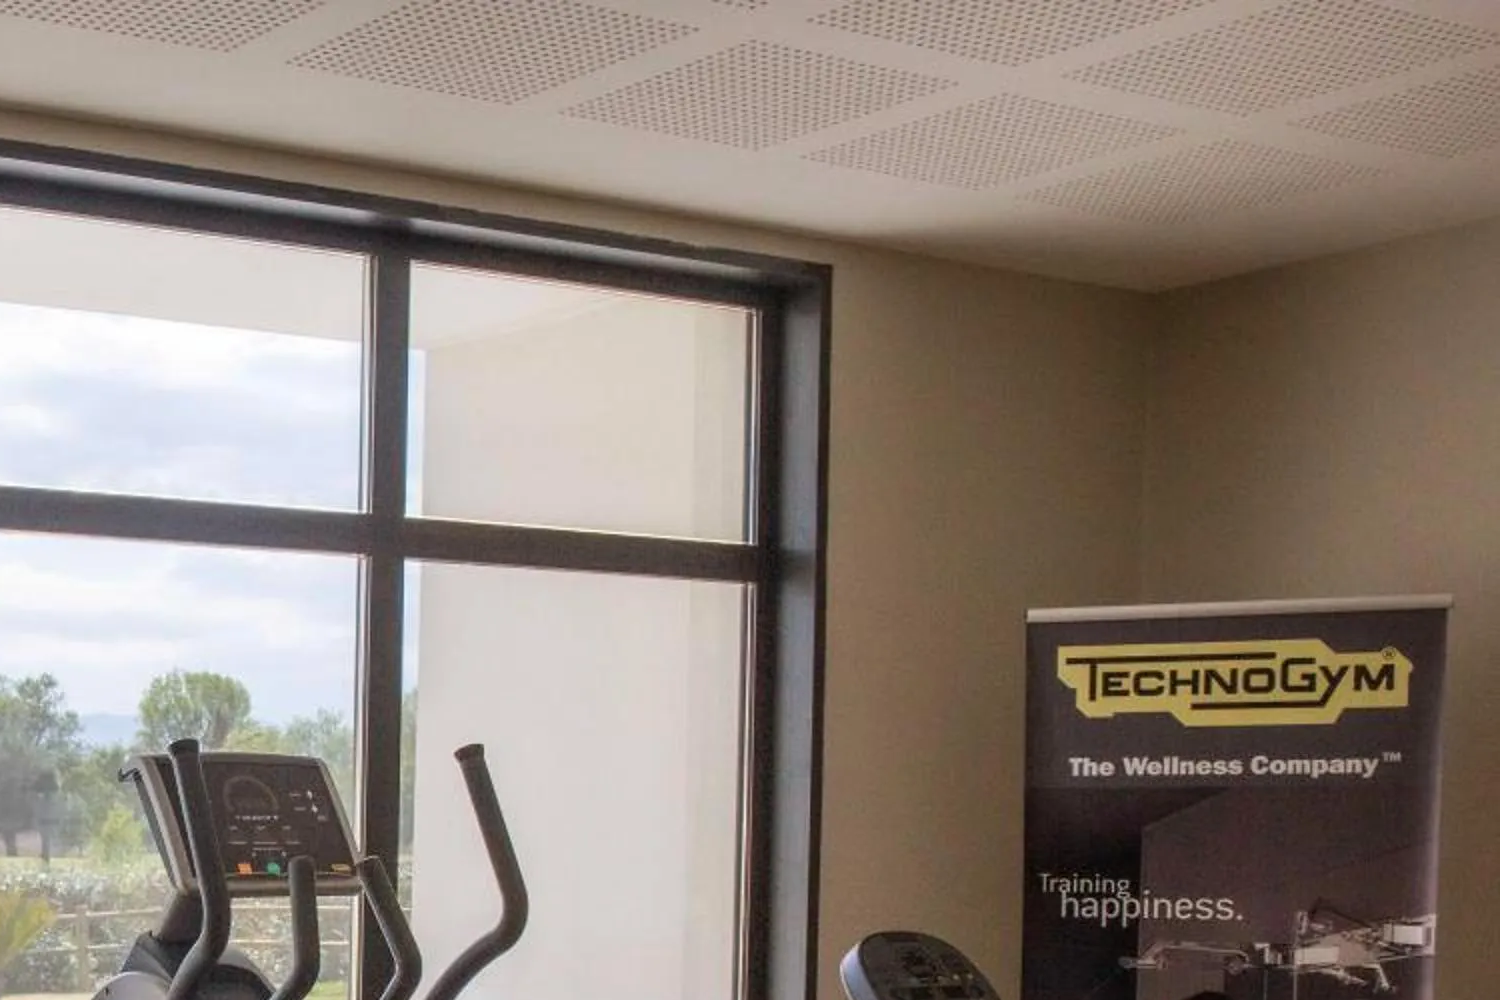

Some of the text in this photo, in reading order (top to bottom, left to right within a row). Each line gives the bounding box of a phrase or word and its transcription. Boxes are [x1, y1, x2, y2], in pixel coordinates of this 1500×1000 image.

[1068, 757, 1116, 777] The
[1122, 755, 1244, 776] Wellness
[1037, 872, 1131, 898] Training
[1060, 888, 1244, 929] happiness.
